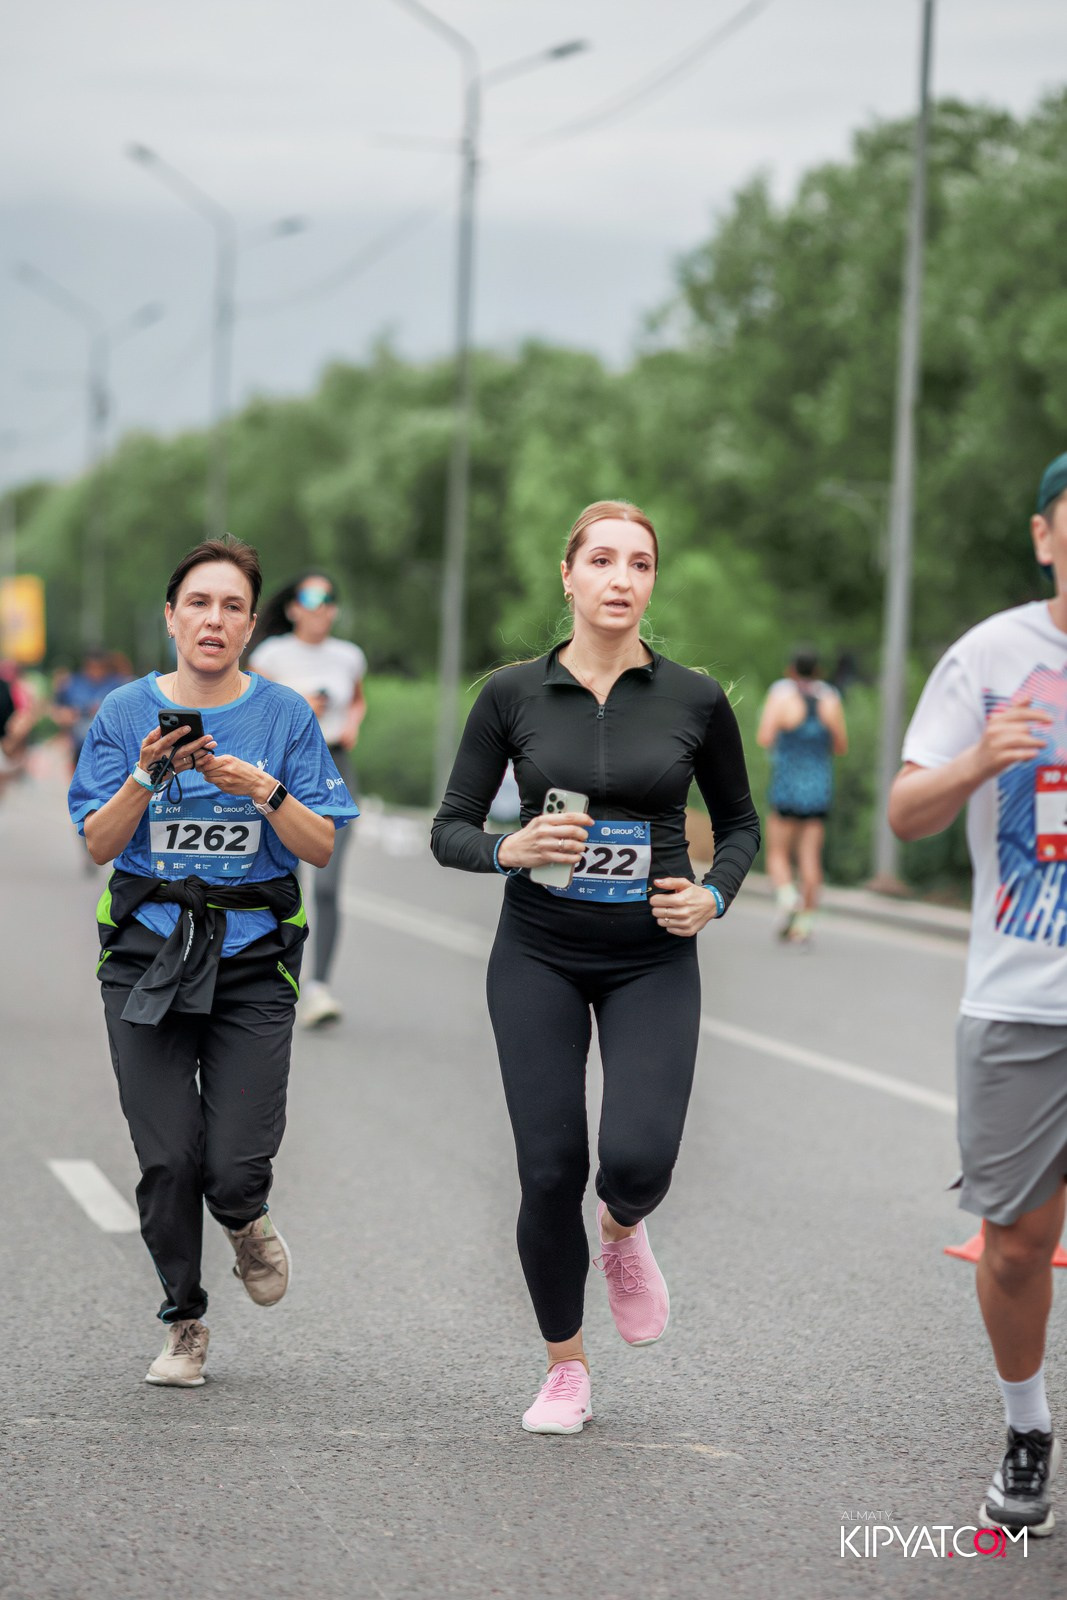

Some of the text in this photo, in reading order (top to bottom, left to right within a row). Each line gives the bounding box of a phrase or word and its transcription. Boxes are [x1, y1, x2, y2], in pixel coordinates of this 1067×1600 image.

[155, 805, 181, 814] 5 KM
[166, 824, 249, 851] 1262
